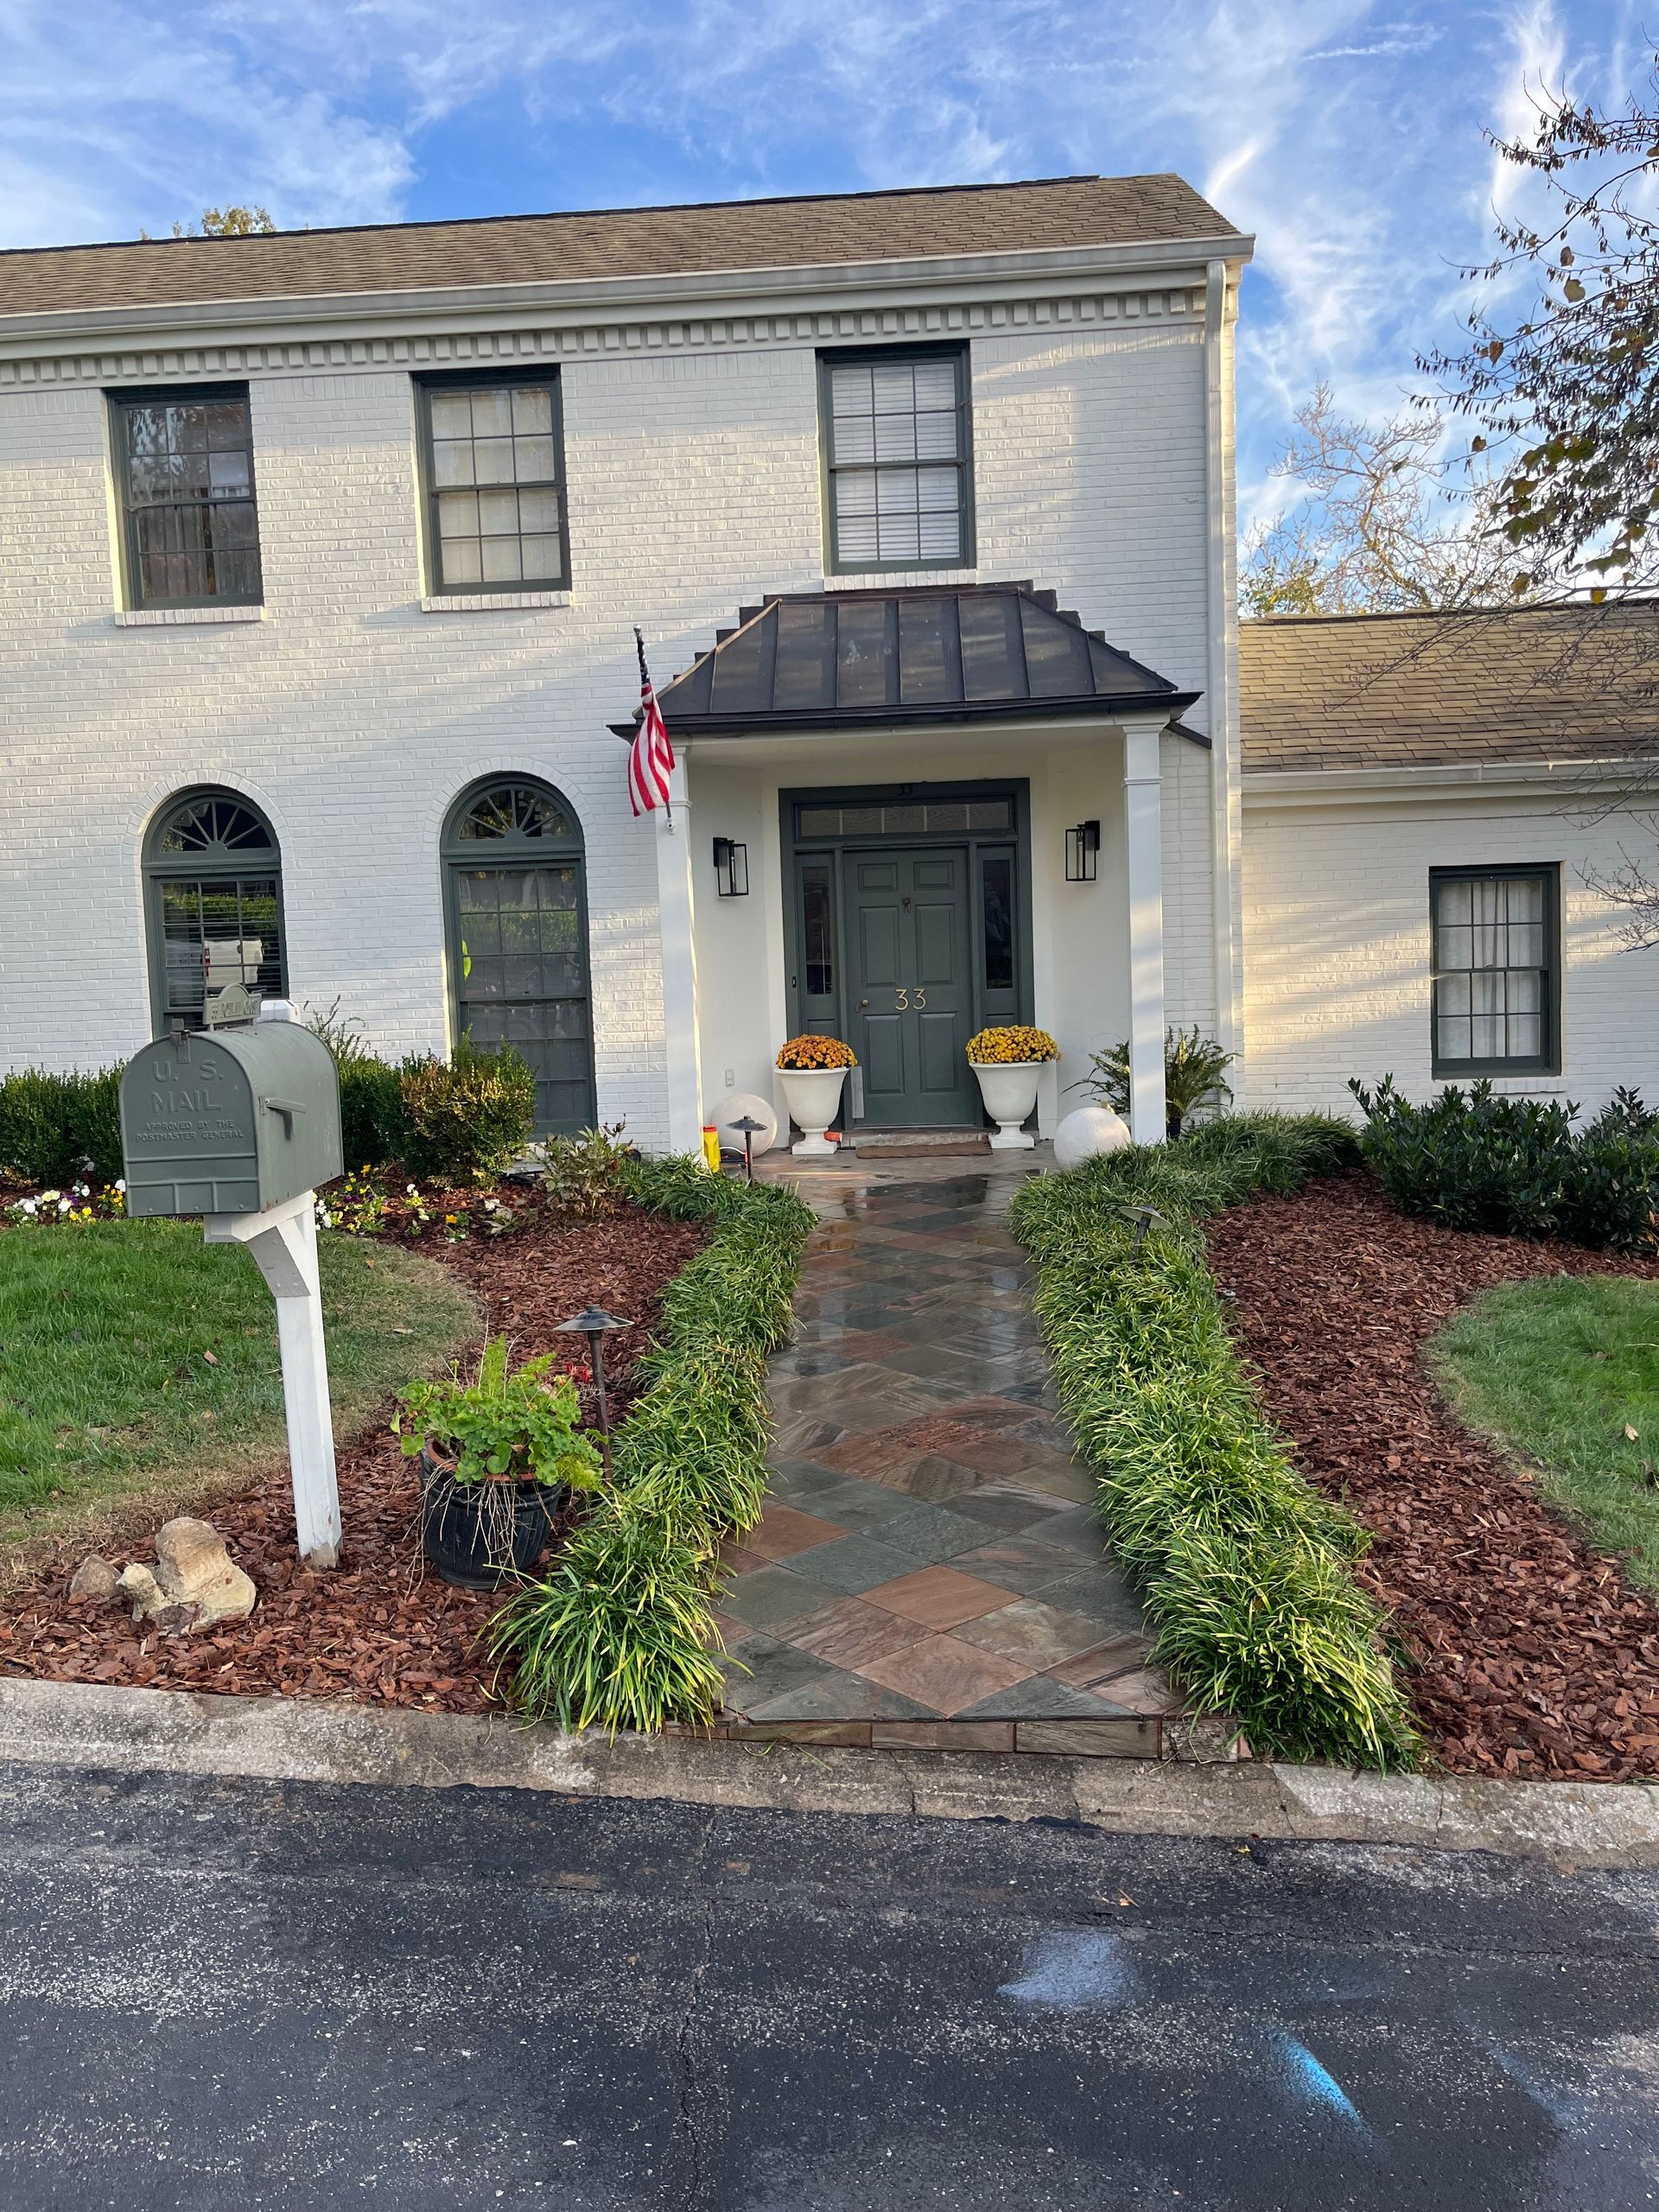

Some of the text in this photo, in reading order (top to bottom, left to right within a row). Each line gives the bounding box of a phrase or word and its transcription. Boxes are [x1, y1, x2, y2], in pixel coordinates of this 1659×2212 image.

[895, 988, 926, 1011] 33
[152, 1059, 225, 1083] U. S.
[151, 1090, 222, 1113] MAIL
[136, 1128, 245, 1143] POSTMASTER GENERAL
[146, 1119, 235, 1132] APPROVED BY THE
